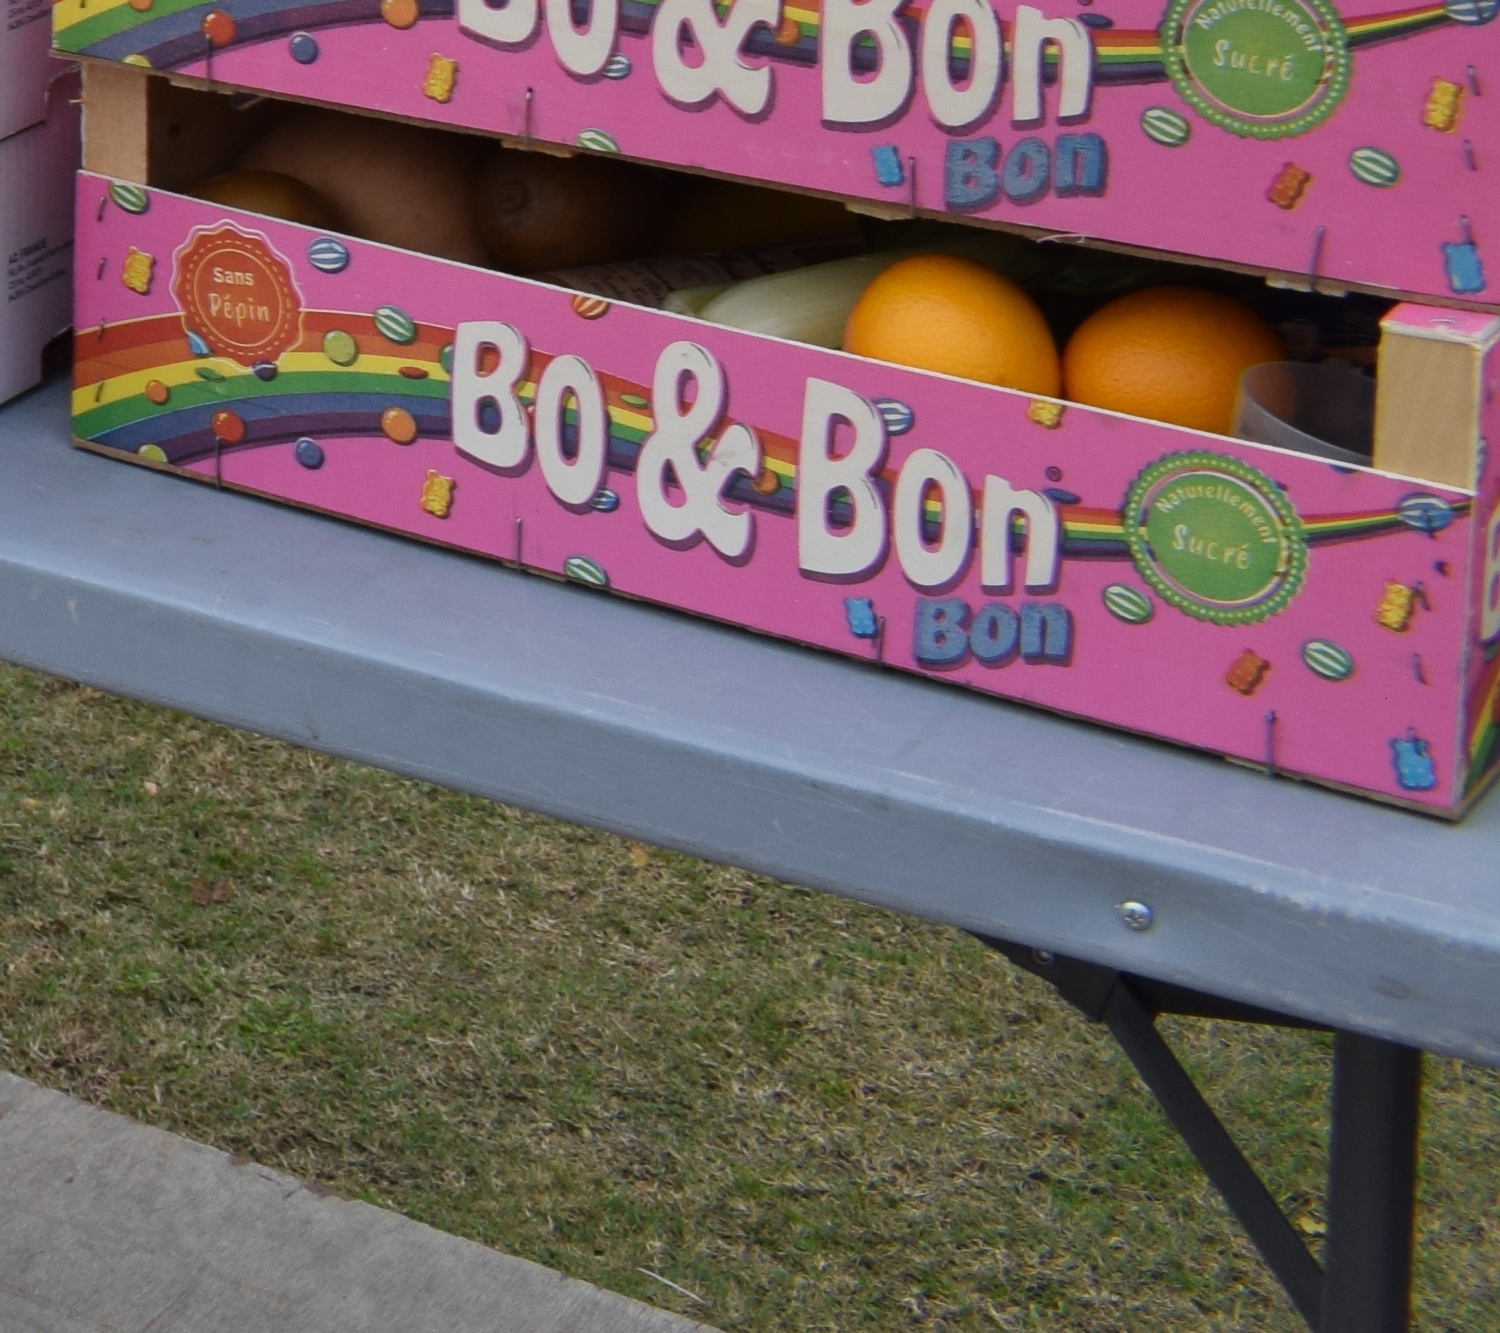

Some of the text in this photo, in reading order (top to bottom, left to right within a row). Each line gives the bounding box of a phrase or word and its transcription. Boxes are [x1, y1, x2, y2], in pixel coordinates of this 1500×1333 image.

[1213, 39, 1295, 82] Sucré
[943, 133, 1107, 211] Bon
[213, 264, 255, 288] Sans
[208, 291, 270, 325] Pépin
[636, 341, 761, 558] &
[799, 376, 1063, 589] Bon
[1157, 481, 1280, 544] Naturellement
[1171, 523, 1250, 572] Sucré
[913, 597, 1073, 667] Bon
